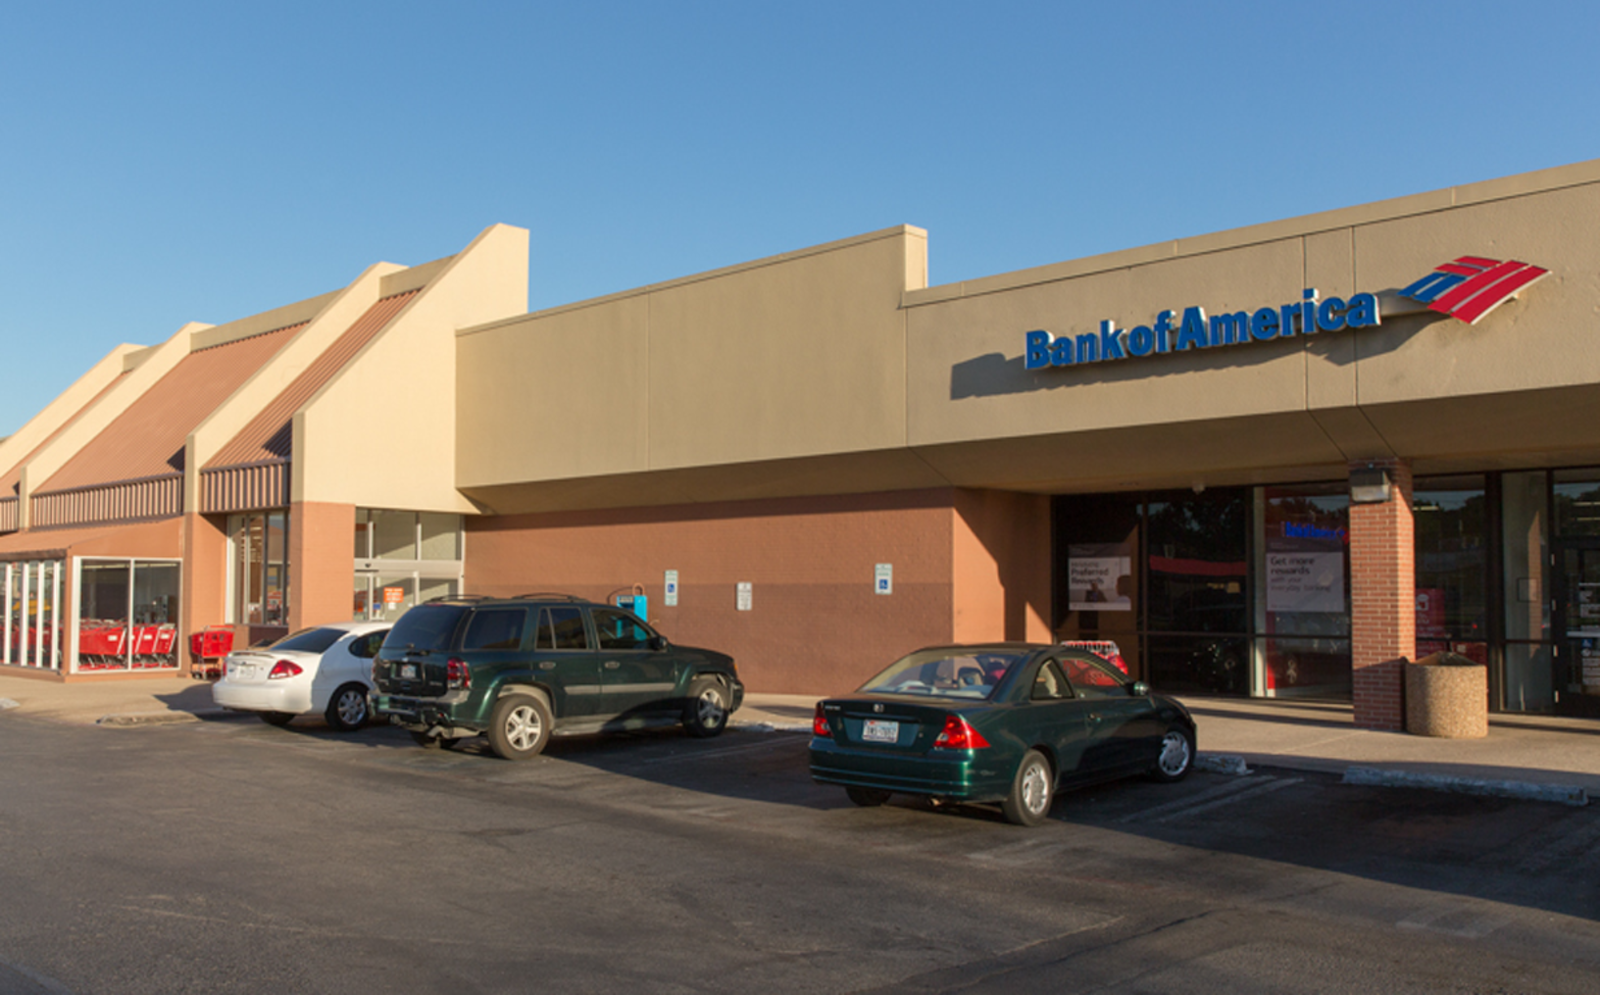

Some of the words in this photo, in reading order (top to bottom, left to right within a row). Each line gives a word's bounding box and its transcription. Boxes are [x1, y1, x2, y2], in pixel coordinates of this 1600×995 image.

[1025, 319, 1127, 369] Bank
[1128, 309, 1176, 356] of
[1175, 287, 1381, 350] America
[1270, 555, 1287, 565] Get
[1071, 568, 1109, 576] Preferred
[1270, 566, 1310, 575] rewards
